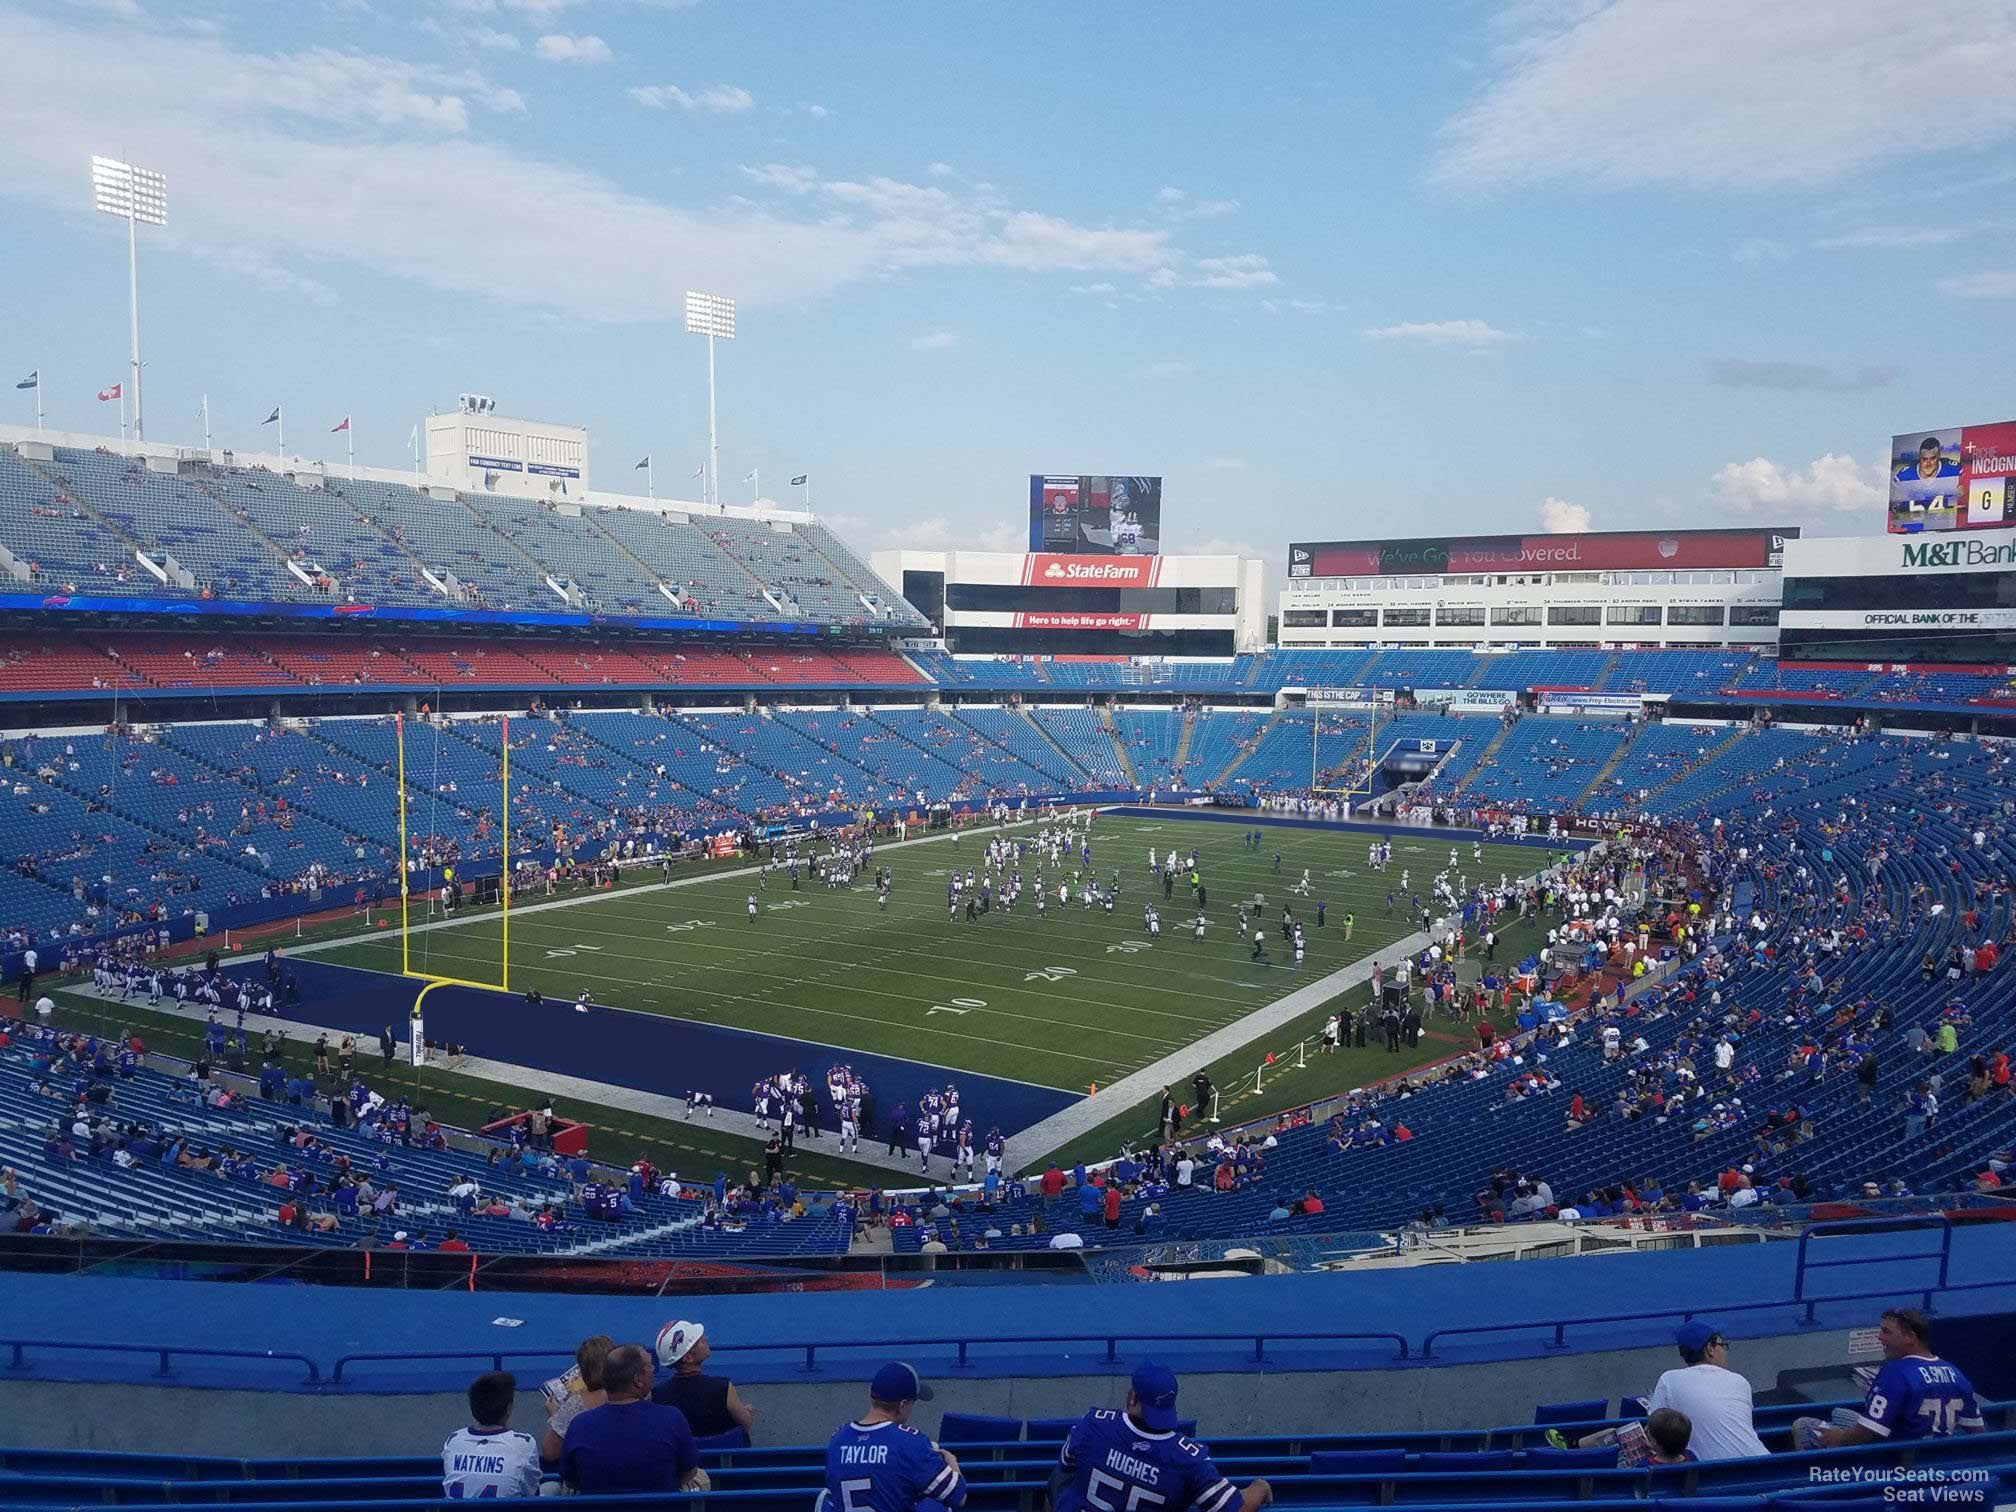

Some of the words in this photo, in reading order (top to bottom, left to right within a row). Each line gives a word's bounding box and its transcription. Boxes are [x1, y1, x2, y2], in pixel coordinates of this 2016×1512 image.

[1981, 490, 1992, 511] G
[1029, 615, 1050, 625] Here
[1051, 616, 1060, 625] to
[1061, 616, 1080, 627] help
[1080, 616, 1095, 625] life
[1095, 618, 1107, 628] go
[1864, 613, 1910, 625] OFFICIAL
[1912, 613, 1940, 625] BANK
[1942, 613, 1956, 624] OF
[1959, 612, 1979, 625] THE
[1466, 691, 1479, 699] GO
[1478, 691, 1507, 699] WHERE
[1023, 966, 1078, 982] 20
[926, 997, 988, 1016] 10
[453, 1454, 505, 1475] WATKINS
[839, 1445, 889, 1465] TAYLOR
[1105, 1447, 1160, 1486] HUGHES
